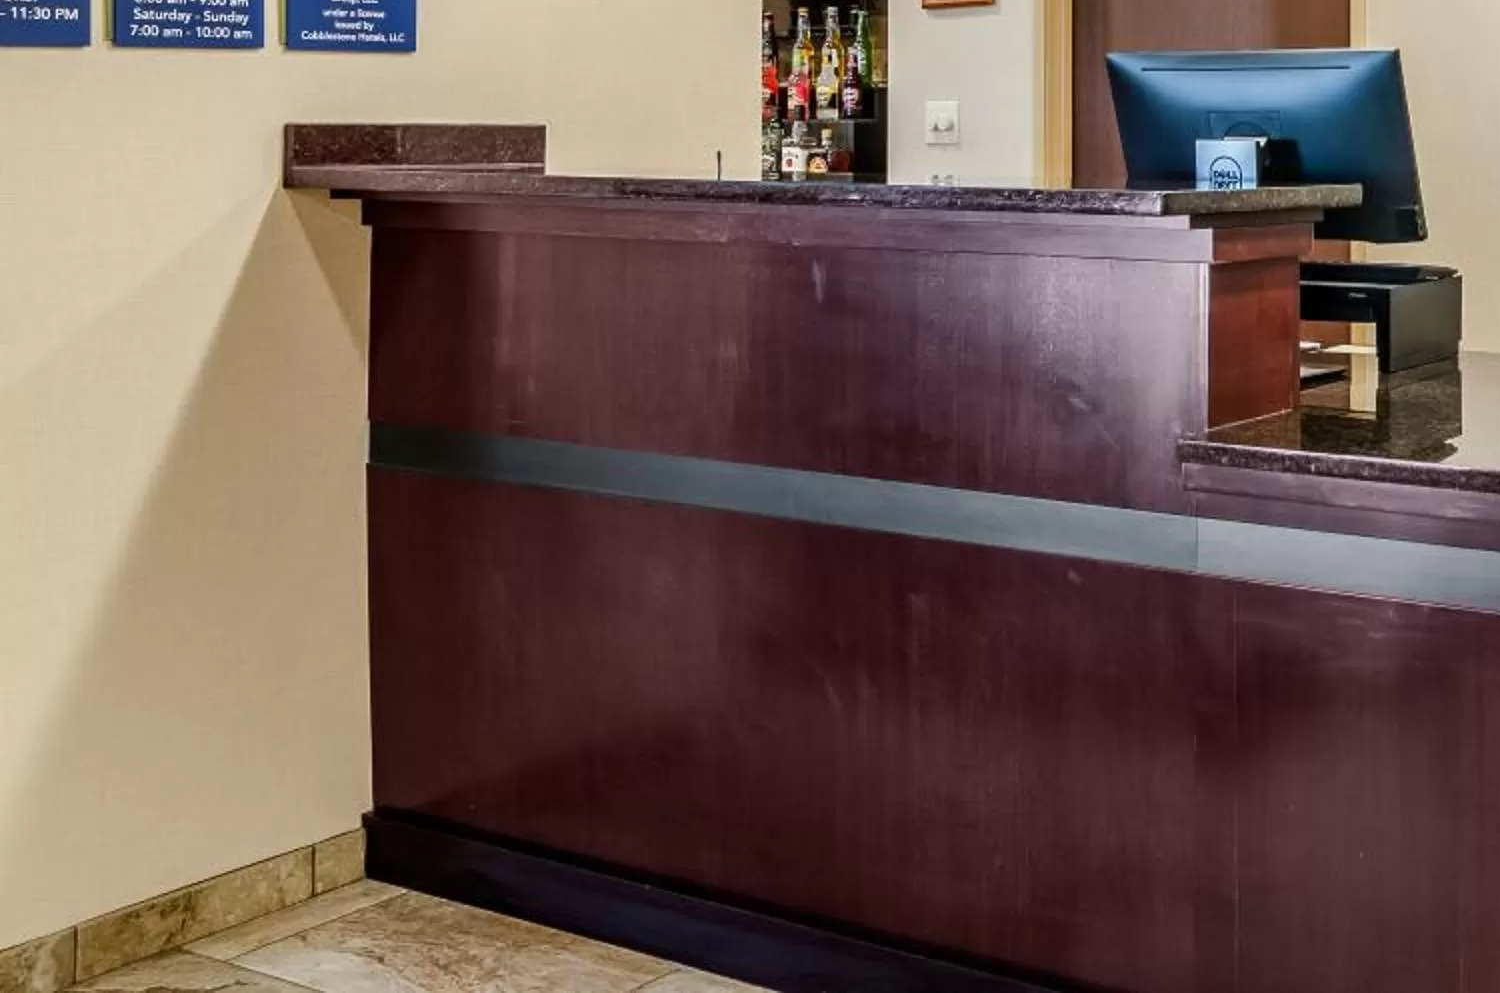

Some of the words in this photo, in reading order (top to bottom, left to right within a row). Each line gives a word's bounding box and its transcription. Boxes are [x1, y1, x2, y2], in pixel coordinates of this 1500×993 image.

[11, 7, 51, 20] 11:30
[55, 8, 79, 20] PM
[133, 7, 192, 23] Saturday
[203, 10, 249, 26] Sunday
[129, 24, 159, 36] 7:00
[162, 27, 183, 38] am
[196, 26, 231, 38] 10:00
[233, 29, 253, 40] am
[363, 21, 375, 32] by
[389, 32, 405, 43] LLC
